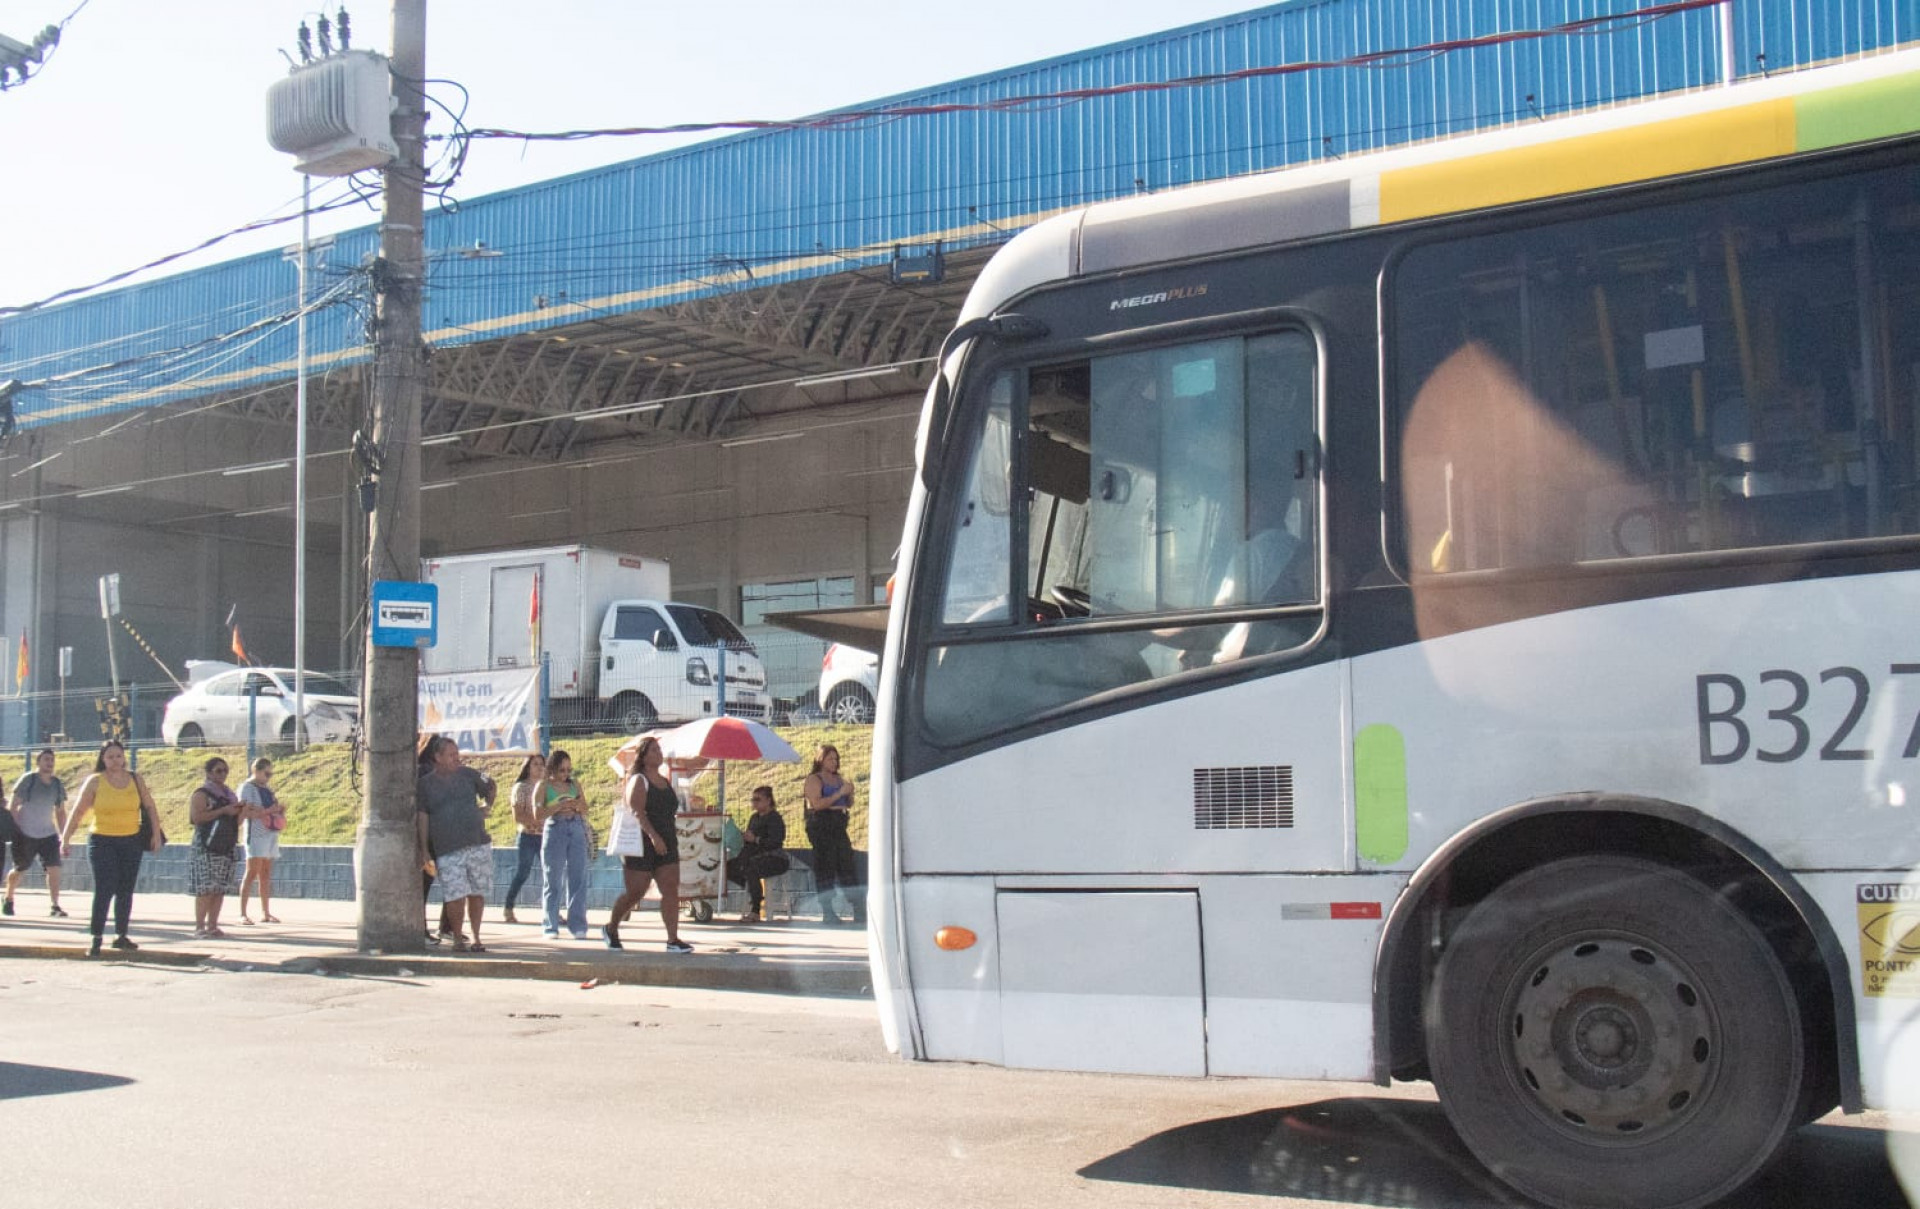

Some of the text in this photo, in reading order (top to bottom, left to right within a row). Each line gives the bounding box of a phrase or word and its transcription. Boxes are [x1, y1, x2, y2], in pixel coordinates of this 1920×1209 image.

[419, 677, 493, 698] Aqui Tem
[1696, 663, 1920, 765] B327
